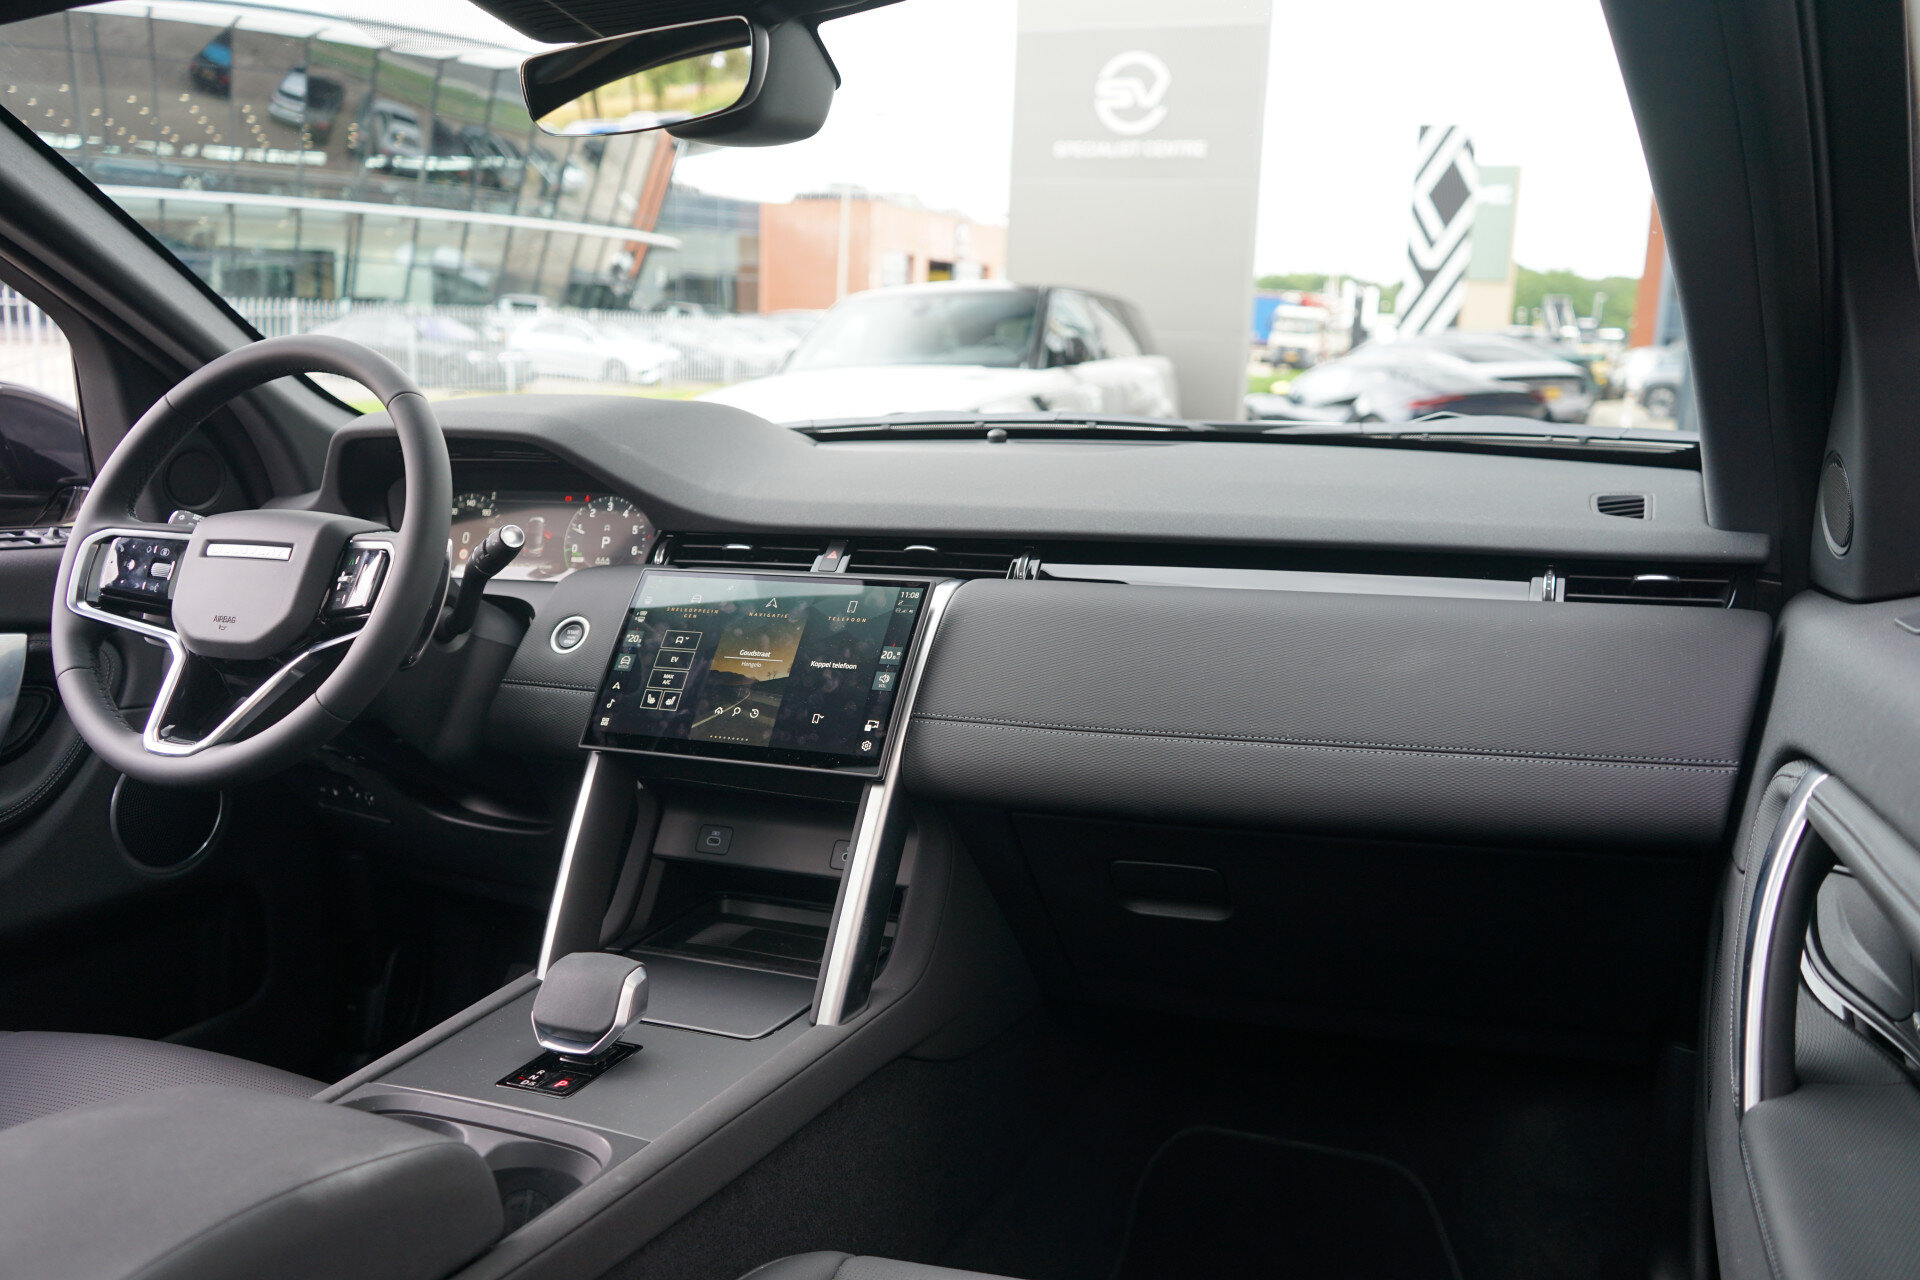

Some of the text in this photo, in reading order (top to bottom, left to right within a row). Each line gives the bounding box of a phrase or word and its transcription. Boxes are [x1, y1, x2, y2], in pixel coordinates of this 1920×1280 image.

[1052, 138, 1208, 158] SPECIALIST CENTRE
[607, 502, 614, 512] 3
[589, 508, 596, 518] 2
[622, 509, 629, 518] 4
[632, 525, 639, 535] 5
[462, 531, 470, 544] 0
[601, 536, 611, 549] P
[631, 546, 638, 556] 6
[900, 591, 920, 599] 11:08
[212, 615, 236, 624] AIRBAG
[739, 649, 772, 658] Goudstraat
[810, 660, 857, 670] Koppel telefoon
[553, 1080, 569, 1088] P
